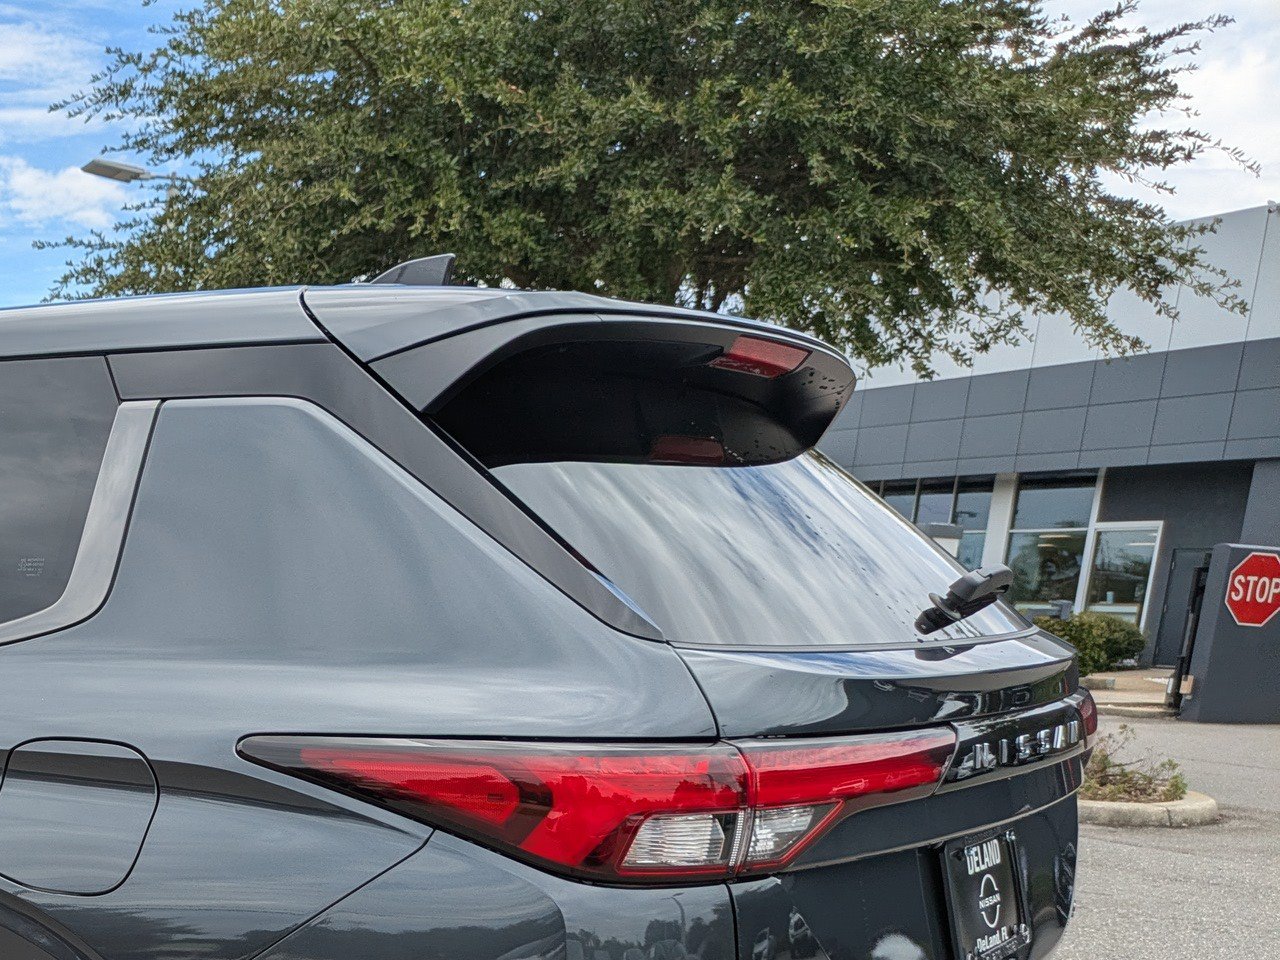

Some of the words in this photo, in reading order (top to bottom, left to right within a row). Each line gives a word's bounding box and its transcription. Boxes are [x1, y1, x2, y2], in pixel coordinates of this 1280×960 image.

[1230, 574, 1280, 604] STOP
[973, 720, 1080, 769] NISSAN
[979, 892, 1001, 909] NISSAN
